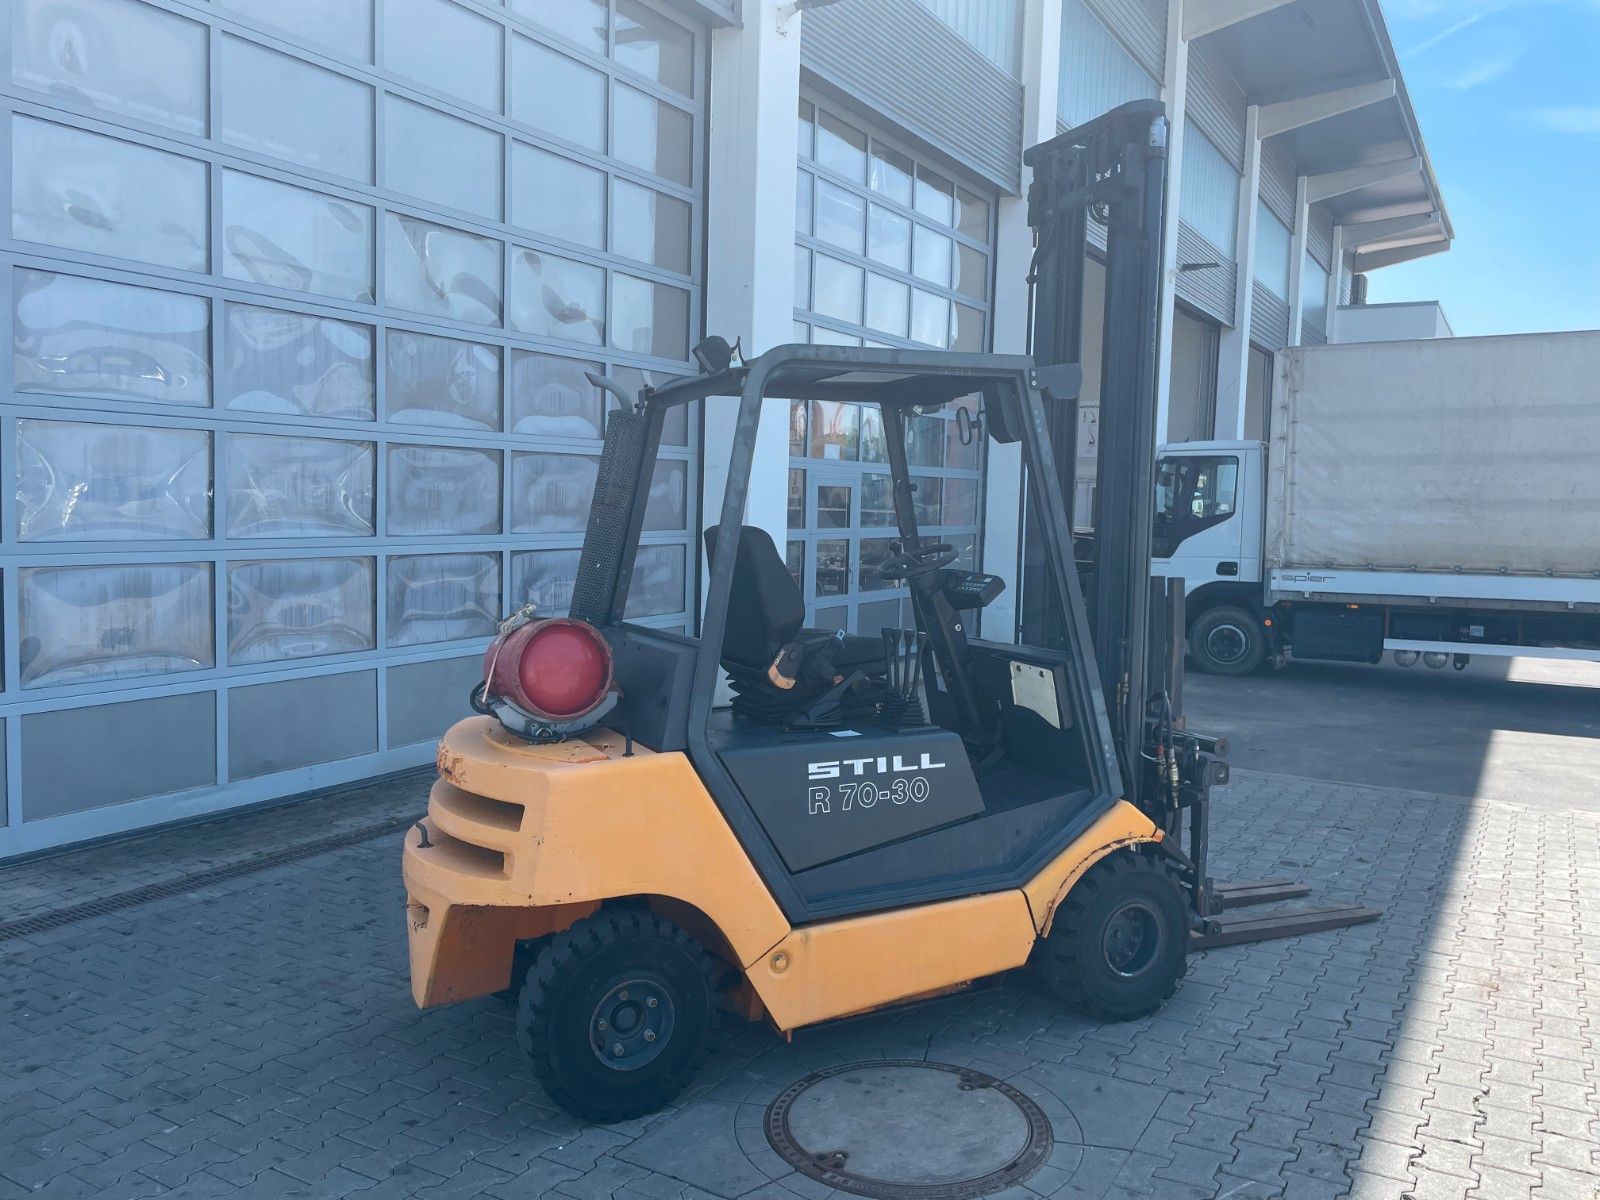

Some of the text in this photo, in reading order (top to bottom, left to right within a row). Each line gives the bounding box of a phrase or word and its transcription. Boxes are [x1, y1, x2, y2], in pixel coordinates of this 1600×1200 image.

[1281, 571, 1336, 583] spier
[808, 753, 946, 780] STILL
[808, 776, 930, 815] R 70-30
